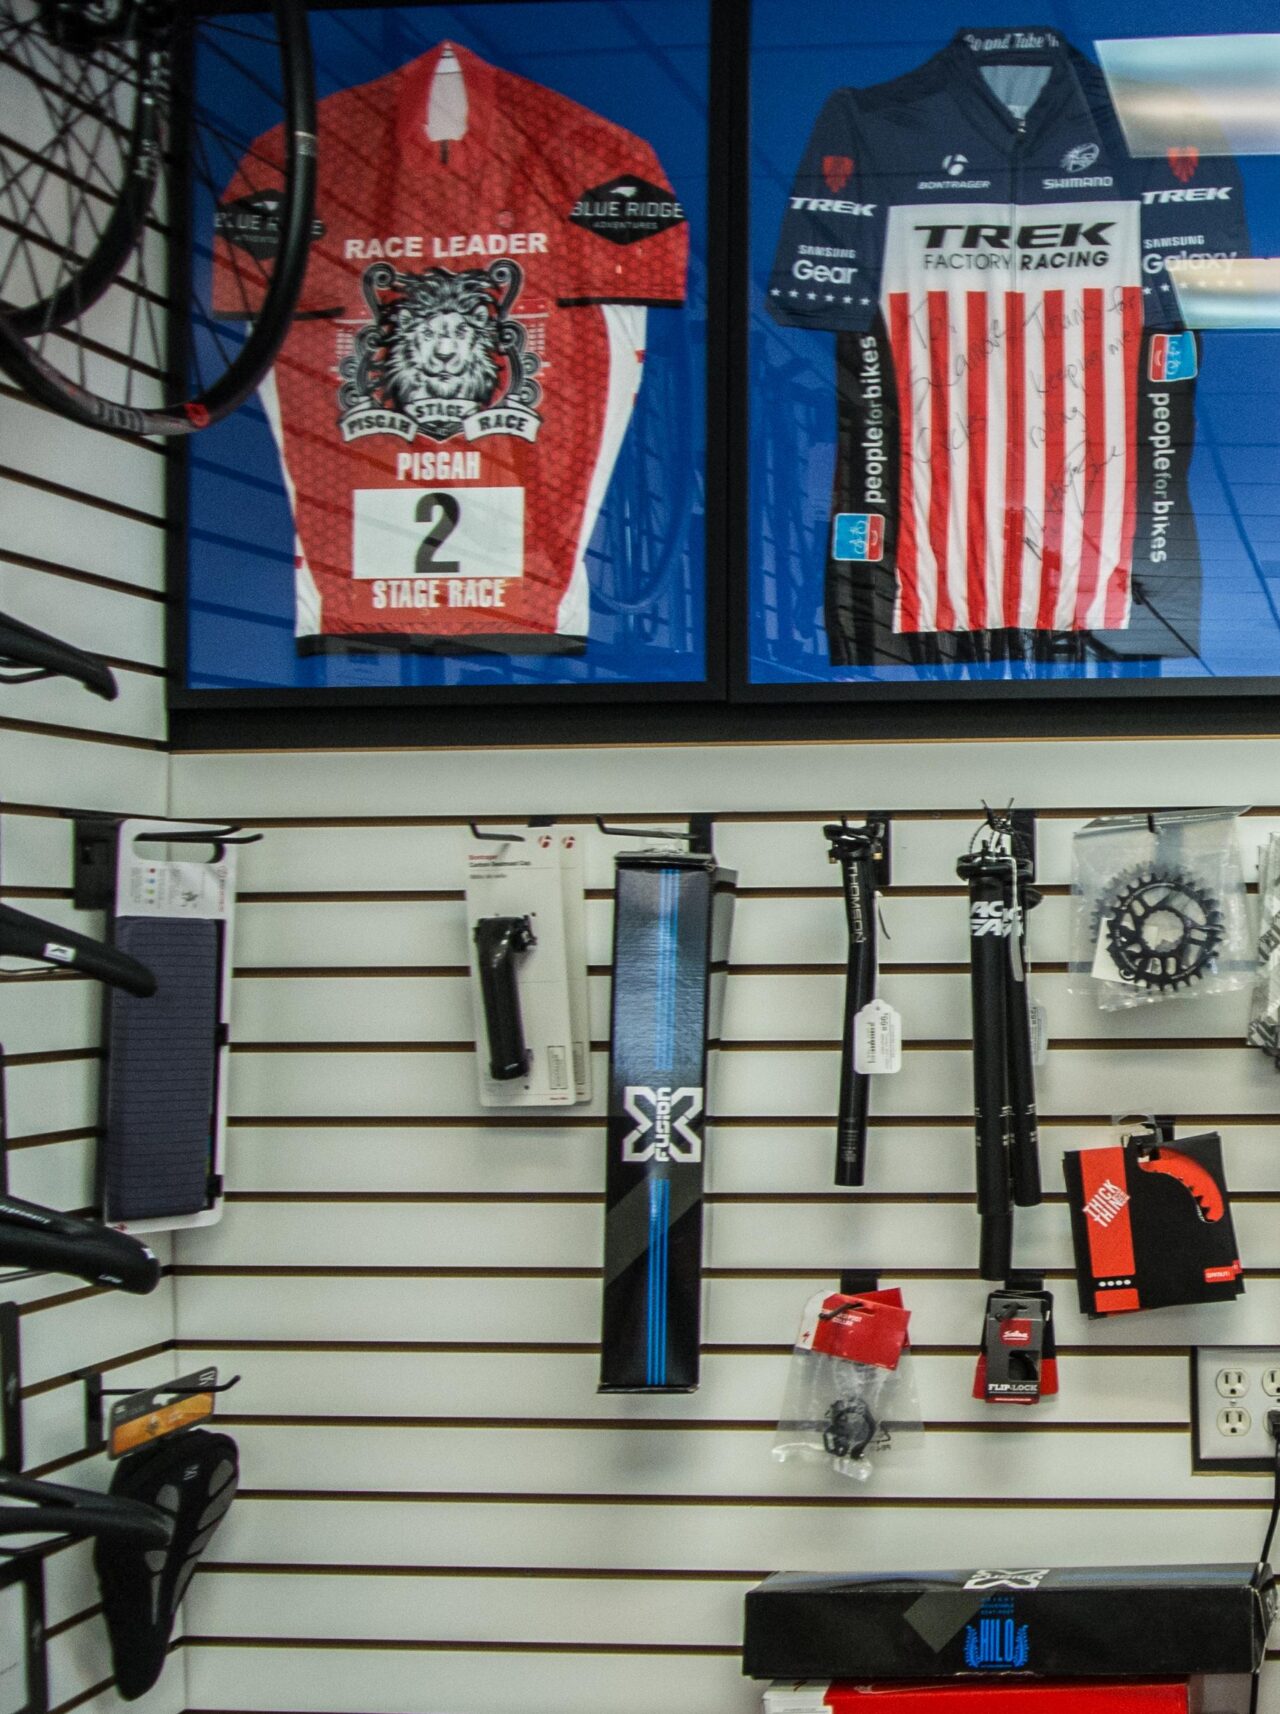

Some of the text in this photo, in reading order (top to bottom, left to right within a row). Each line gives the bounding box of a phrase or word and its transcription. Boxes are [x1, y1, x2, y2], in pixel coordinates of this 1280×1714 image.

[917, 179, 991, 190] BONTRAGER
[1042, 176, 1113, 190] SHIMANO
[789, 196, 877, 217] TREK
[1141, 186, 1233, 205] TREK
[571, 200, 684, 219] BLUE RIDGE
[345, 233, 548, 260] RACE LEADER
[914, 222, 1118, 249] TREK
[1144, 235, 1205, 249] SAMSUNG
[798, 244, 857, 259] SAMSUNG
[923, 250, 1109, 271] FACTORY RACING
[1143, 250, 1238, 274] Galaxy
[793, 260, 857, 284] Gear
[415, 403, 464, 418] STAGE
[858, 335, 888, 504] peopleforbikes
[347, 415, 412, 435] PISGAH
[478, 414, 529, 432] RACE
[397, 451, 481, 480] PISGAH
[1147, 392, 1171, 564] peopleforbikes
[414, 491, 461, 573] 2
[372, 578, 506, 609] STAGE RACE
[849, 861, 866, 944] THOMSON
[1082, 1179, 1120, 1217] THICK
[988, 1383, 1038, 1392] FLIP-LOCK
[981, 1619, 1014, 1662] HILO
